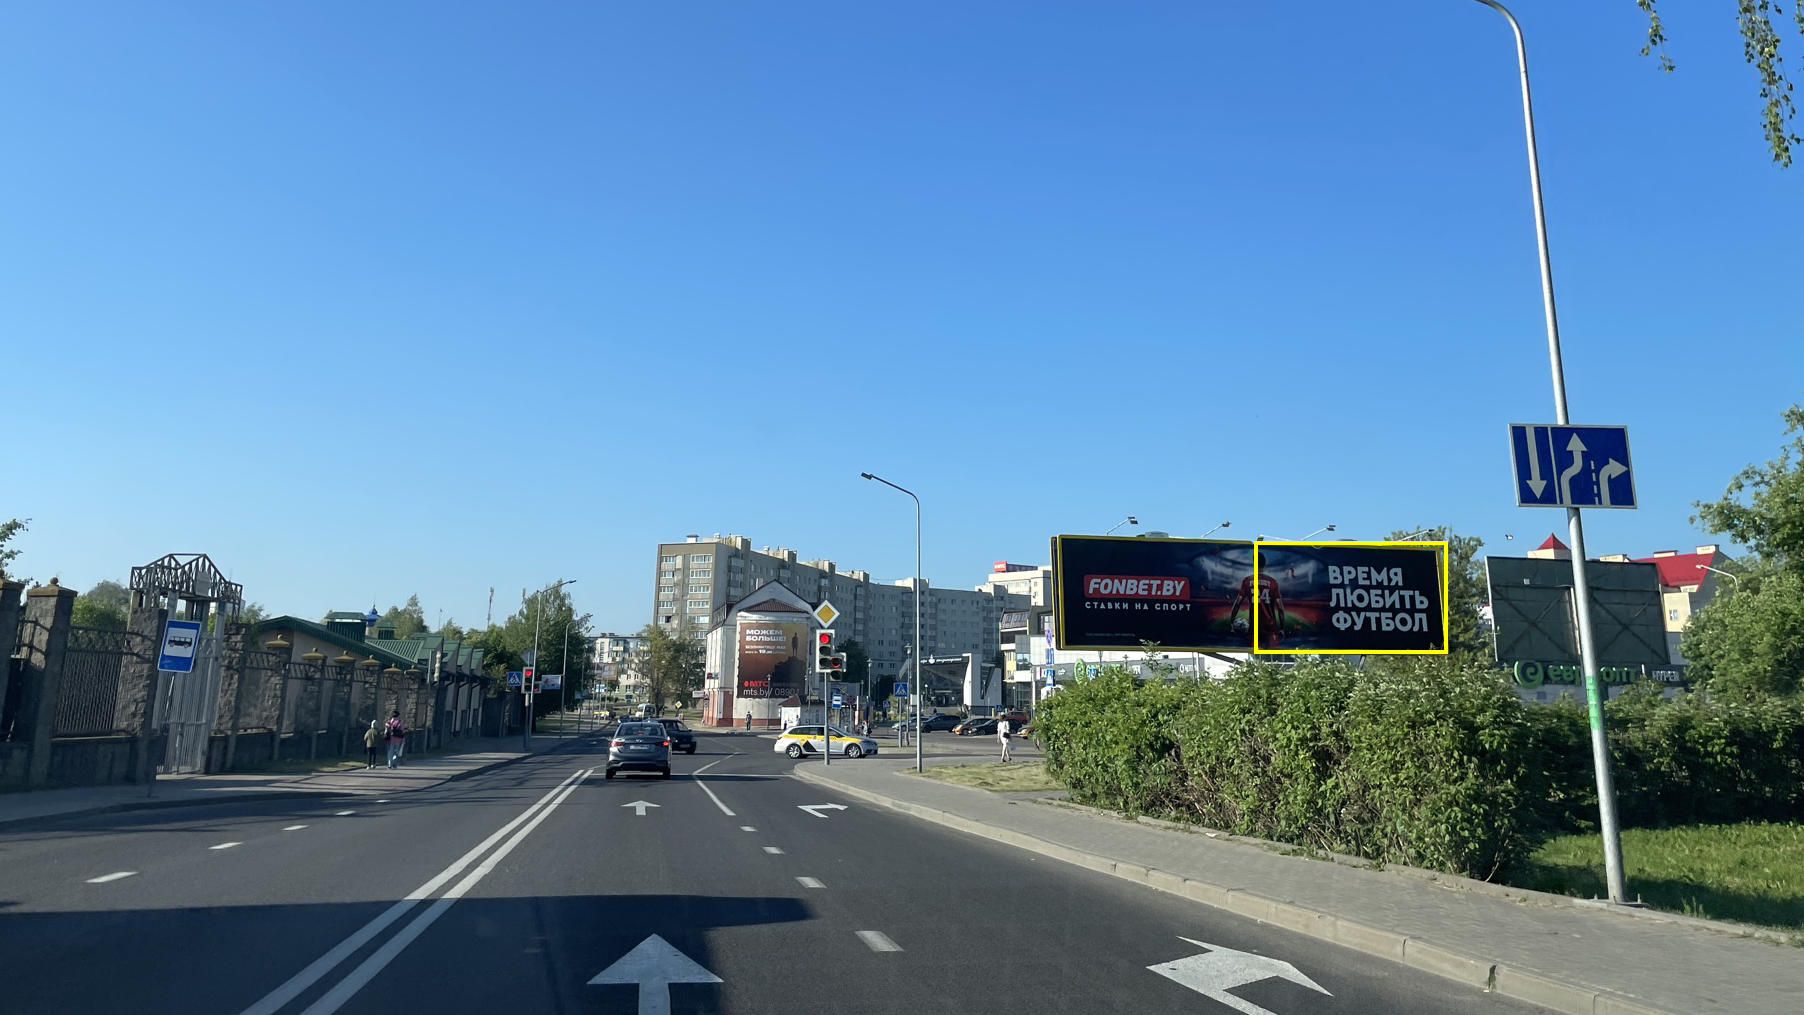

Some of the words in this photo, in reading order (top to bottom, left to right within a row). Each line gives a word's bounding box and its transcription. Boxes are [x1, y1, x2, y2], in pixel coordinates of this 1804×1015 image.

[1328, 565, 1403, 586] ВРЕМЯ
[1088, 578, 1185, 596] FONBET.BY
[1085, 601, 1129, 610] СТАВКИ
[1135, 602, 1149, 610] НА
[1154, 603, 1191, 611] СПОРТ
[1330, 588, 1429, 609] ЛЮБИТЬ
[1332, 610, 1429, 632] ФУТБОЛ
